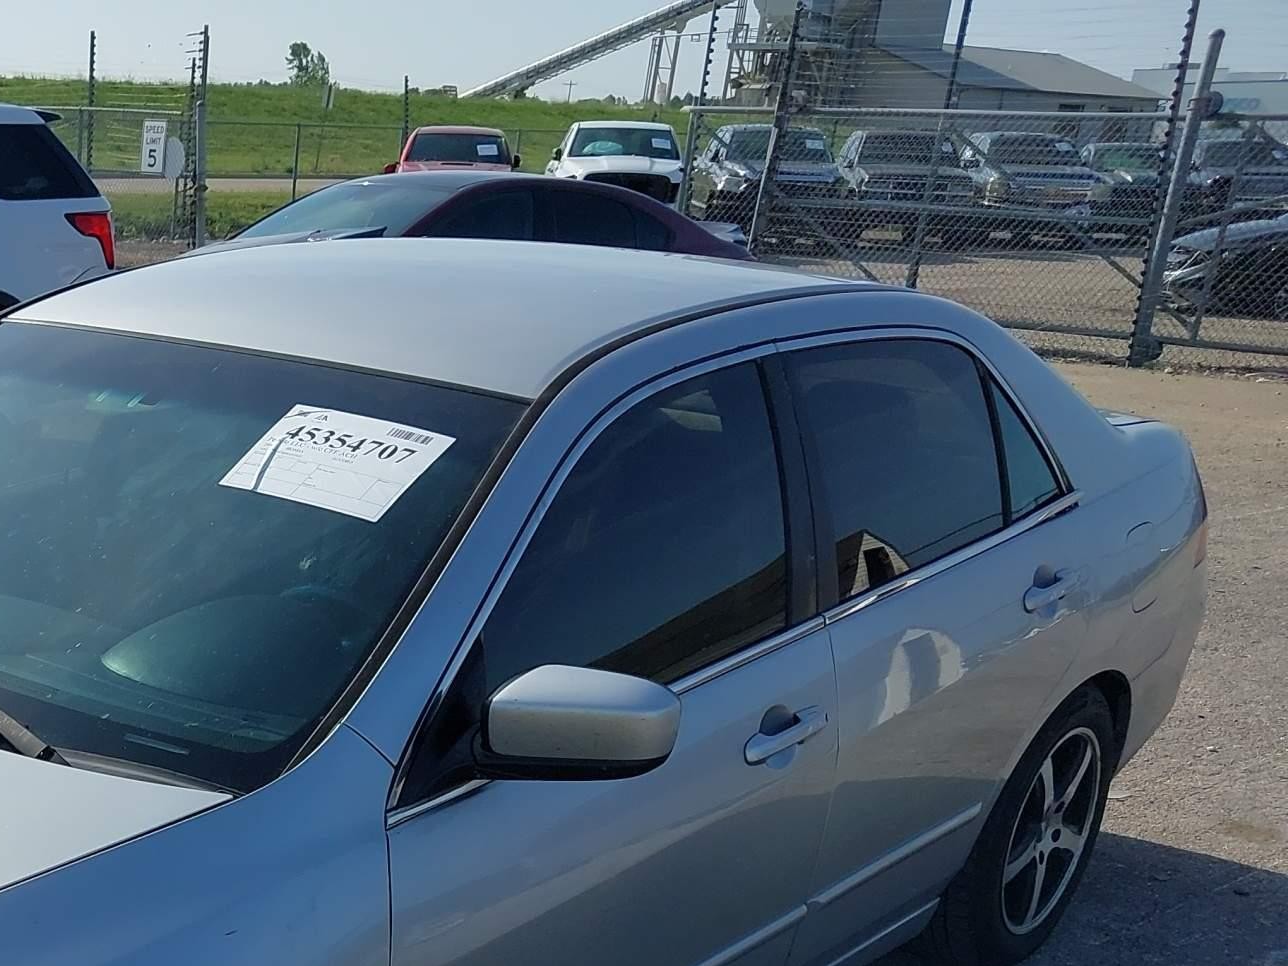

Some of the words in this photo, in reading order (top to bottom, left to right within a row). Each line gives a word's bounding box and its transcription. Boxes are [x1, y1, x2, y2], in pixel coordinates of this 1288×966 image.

[145, 125, 165, 134] SPEED
[145, 137, 162, 145] LIMIT
[147, 149, 157, 168] 5
[285, 425, 418, 464] 45354707
